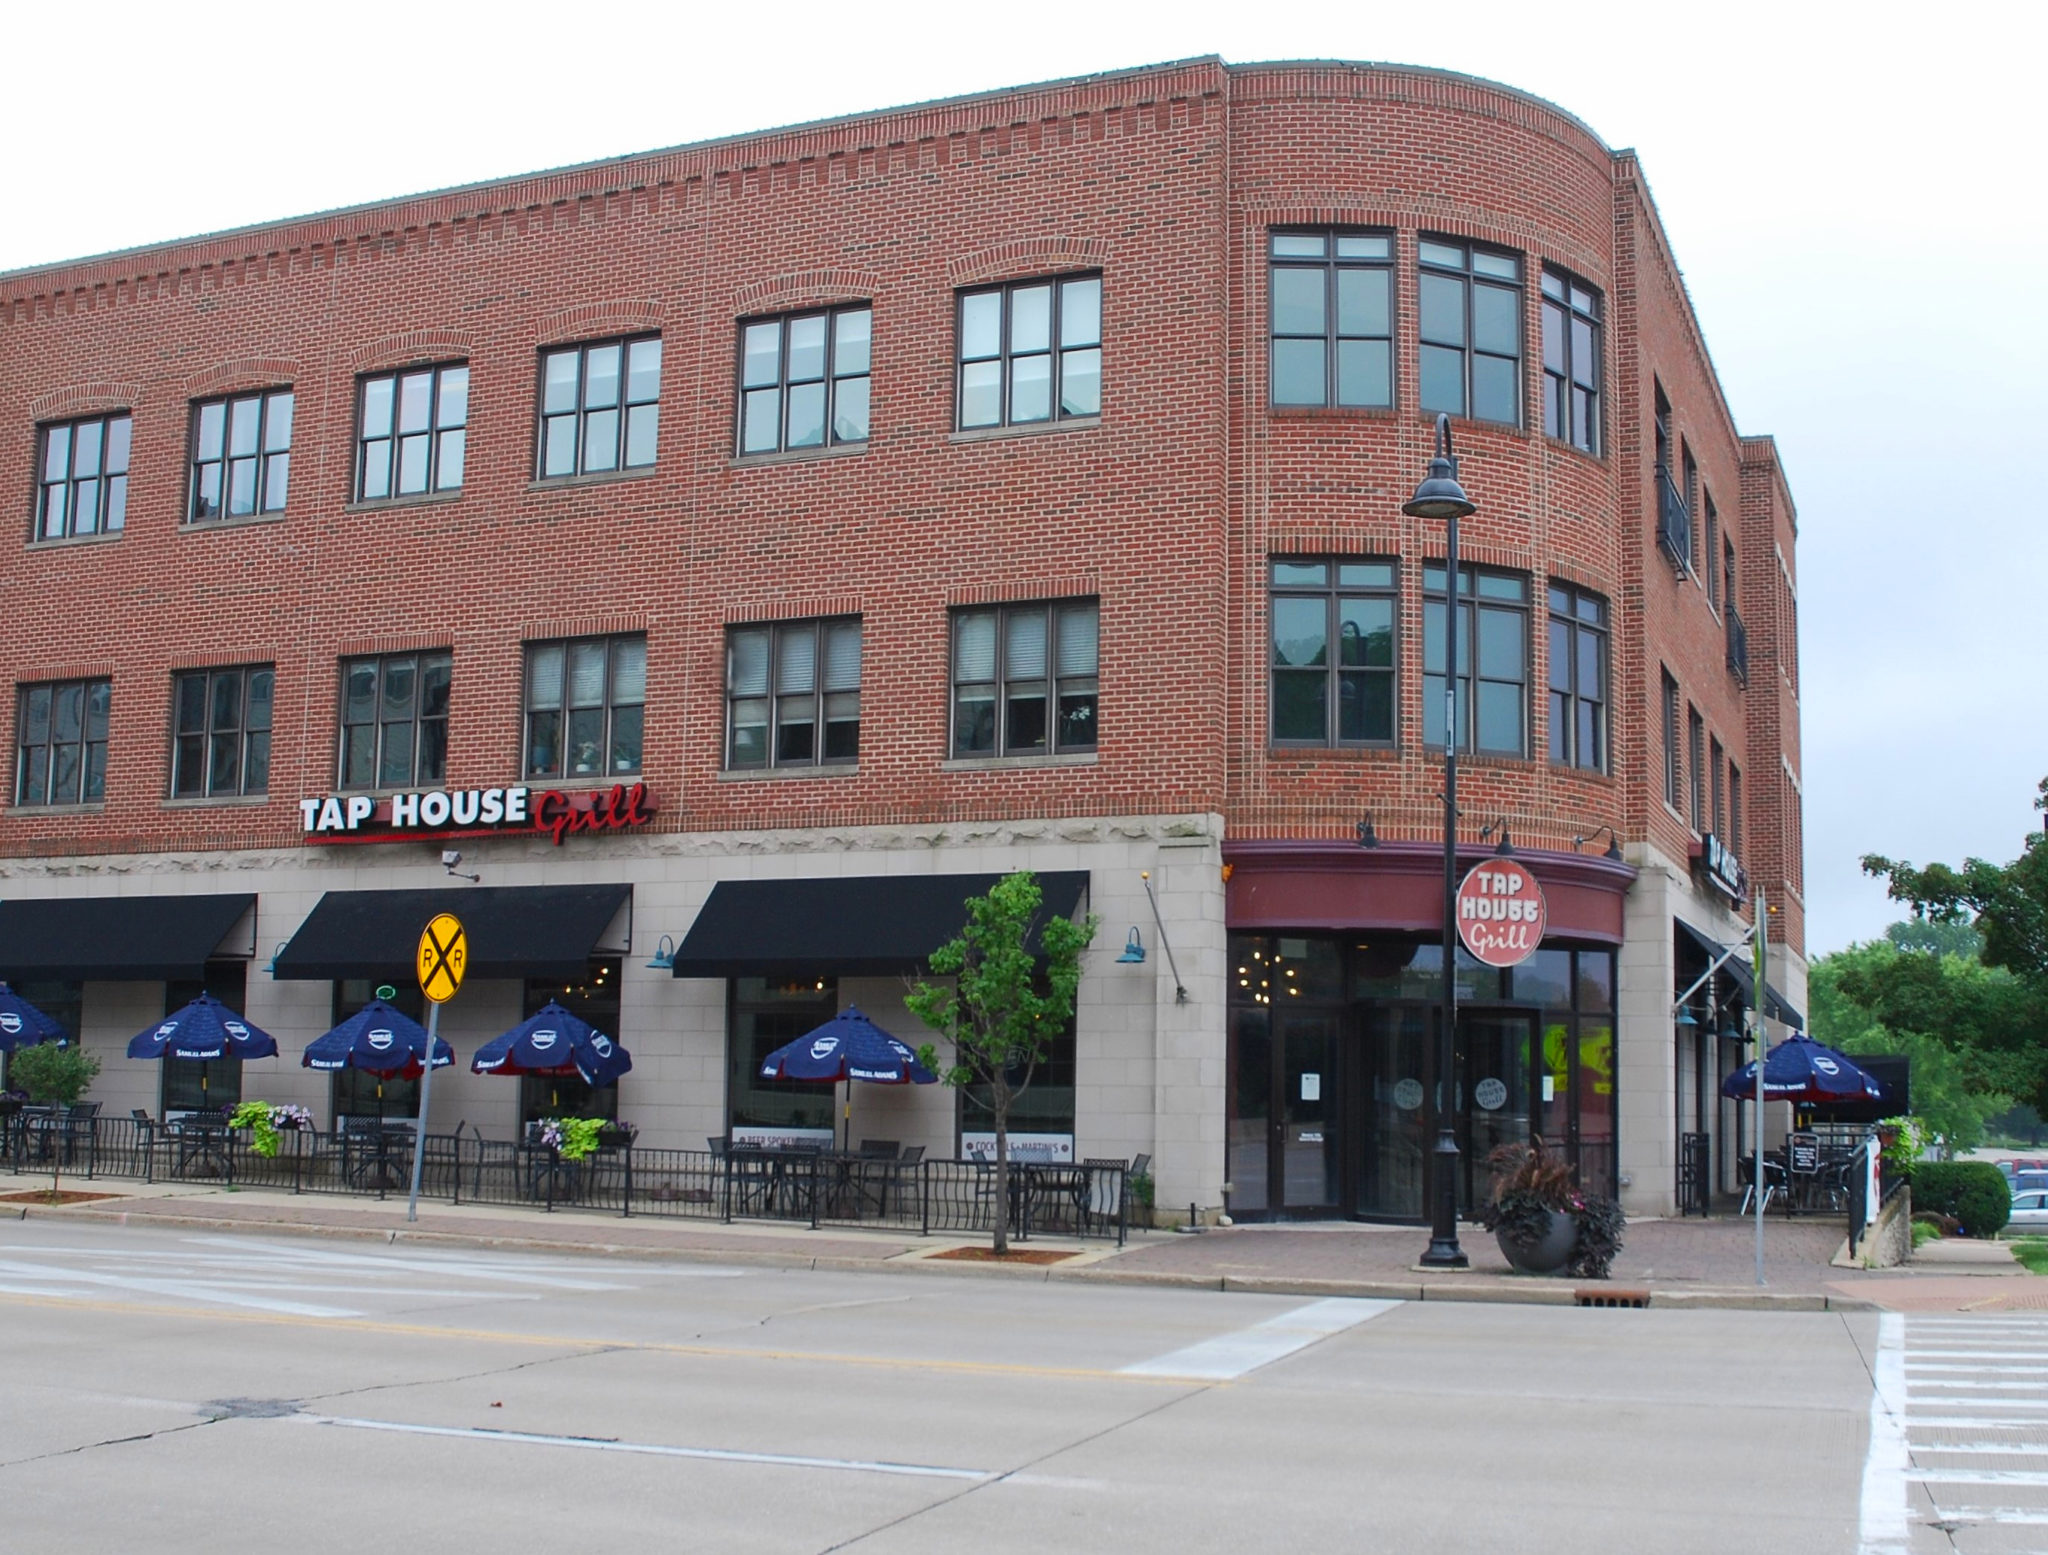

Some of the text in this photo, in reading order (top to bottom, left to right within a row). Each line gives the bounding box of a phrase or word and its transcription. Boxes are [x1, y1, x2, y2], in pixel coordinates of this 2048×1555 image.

[300, 782, 647, 846] TAP HOUSE Grill
[1477, 871, 1523, 896] TAP
[1461, 896, 1539, 922] HOUSE
[1470, 923, 1529, 956] Grill
